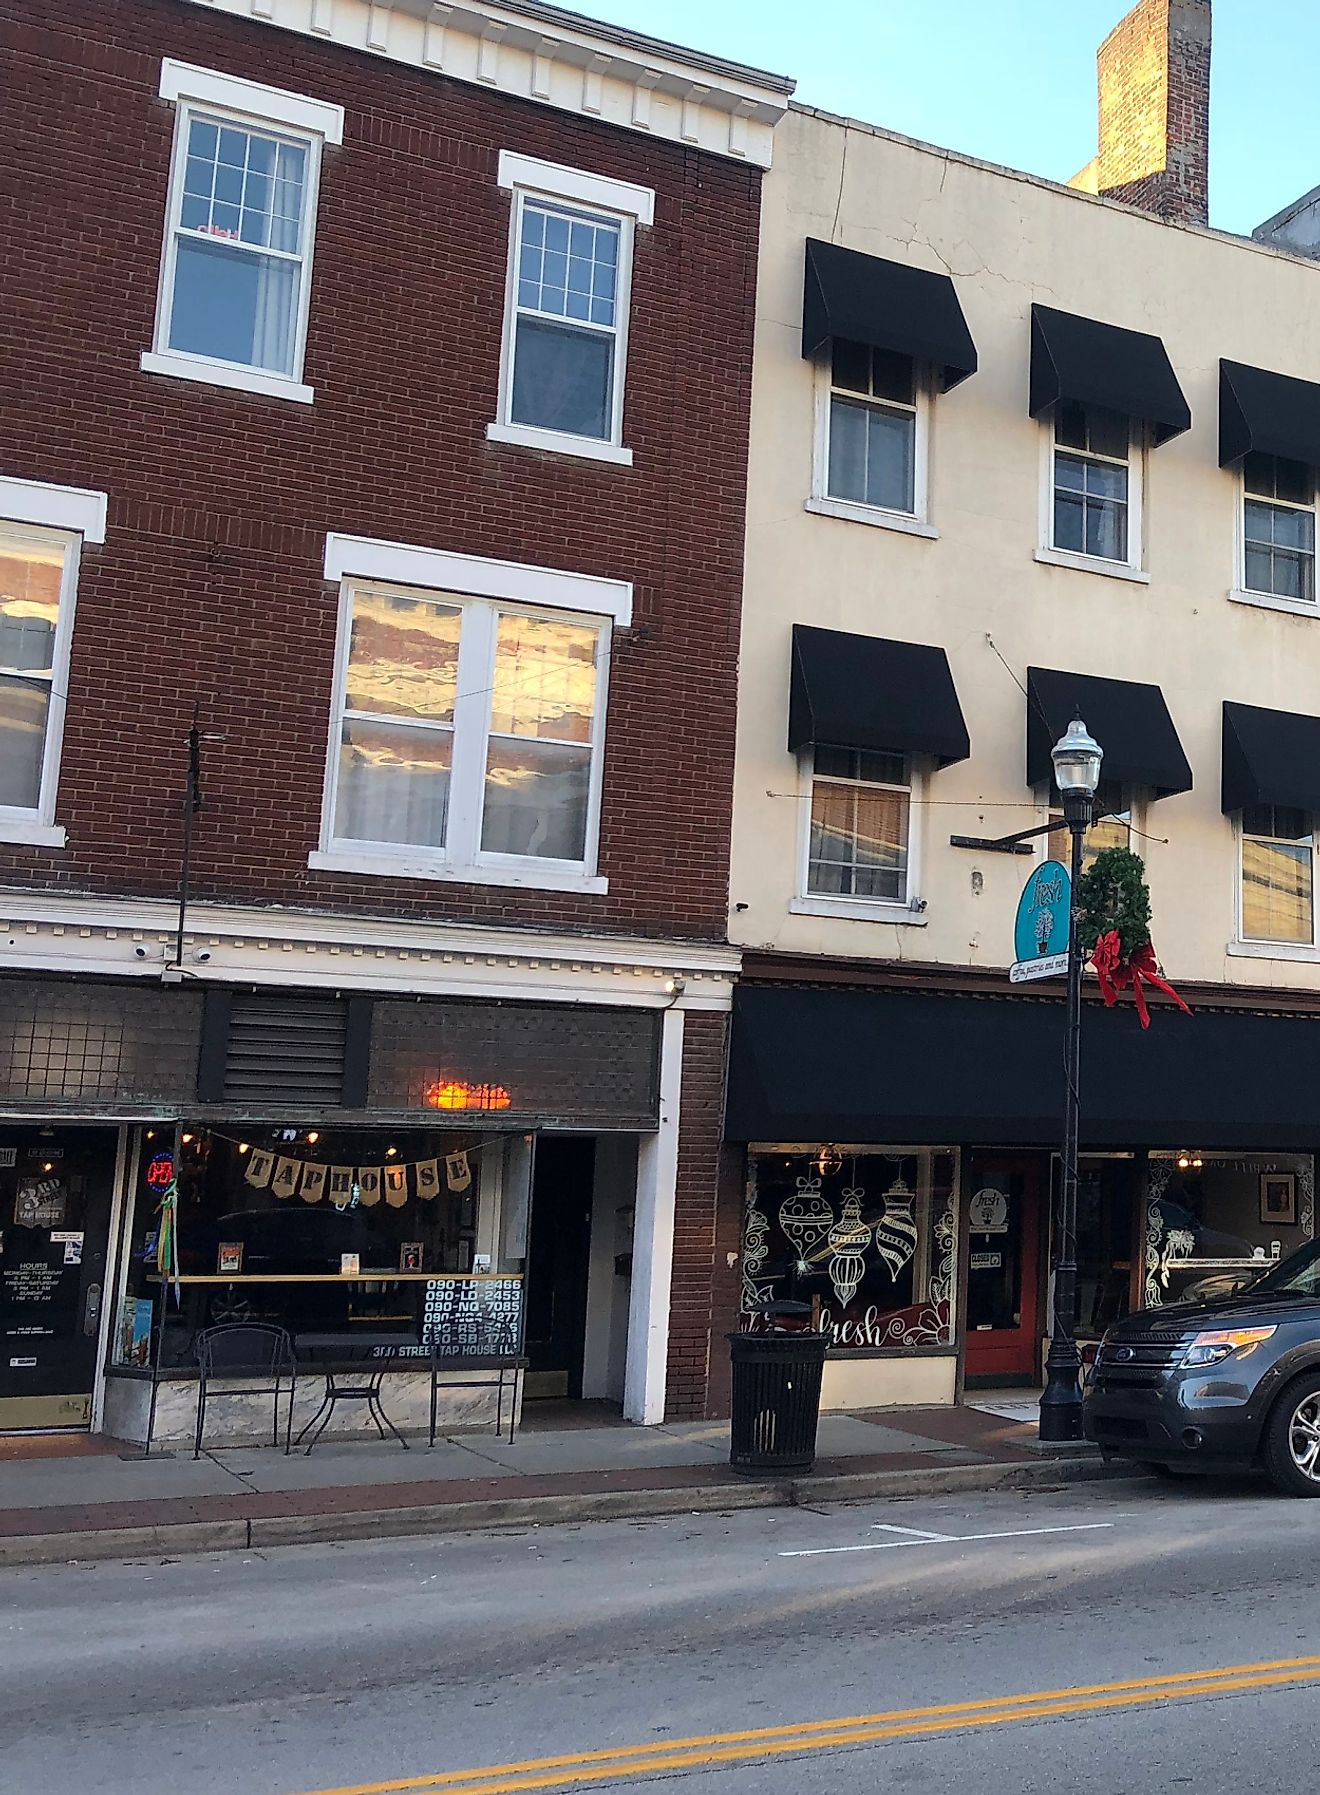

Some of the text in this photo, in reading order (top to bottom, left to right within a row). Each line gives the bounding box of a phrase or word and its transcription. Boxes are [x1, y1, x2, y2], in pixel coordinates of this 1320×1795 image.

[253, 1156, 468, 1192] TAPHOUSE
[425, 1290, 520, 1301] 090-LD-2453
[424, 1301, 519, 1312] 090-NQ-7085
[820, 1305, 881, 1349] fresh
[440, 1345, 459, 1356] TAP
[461, 1344, 496, 1355] HOUSE
